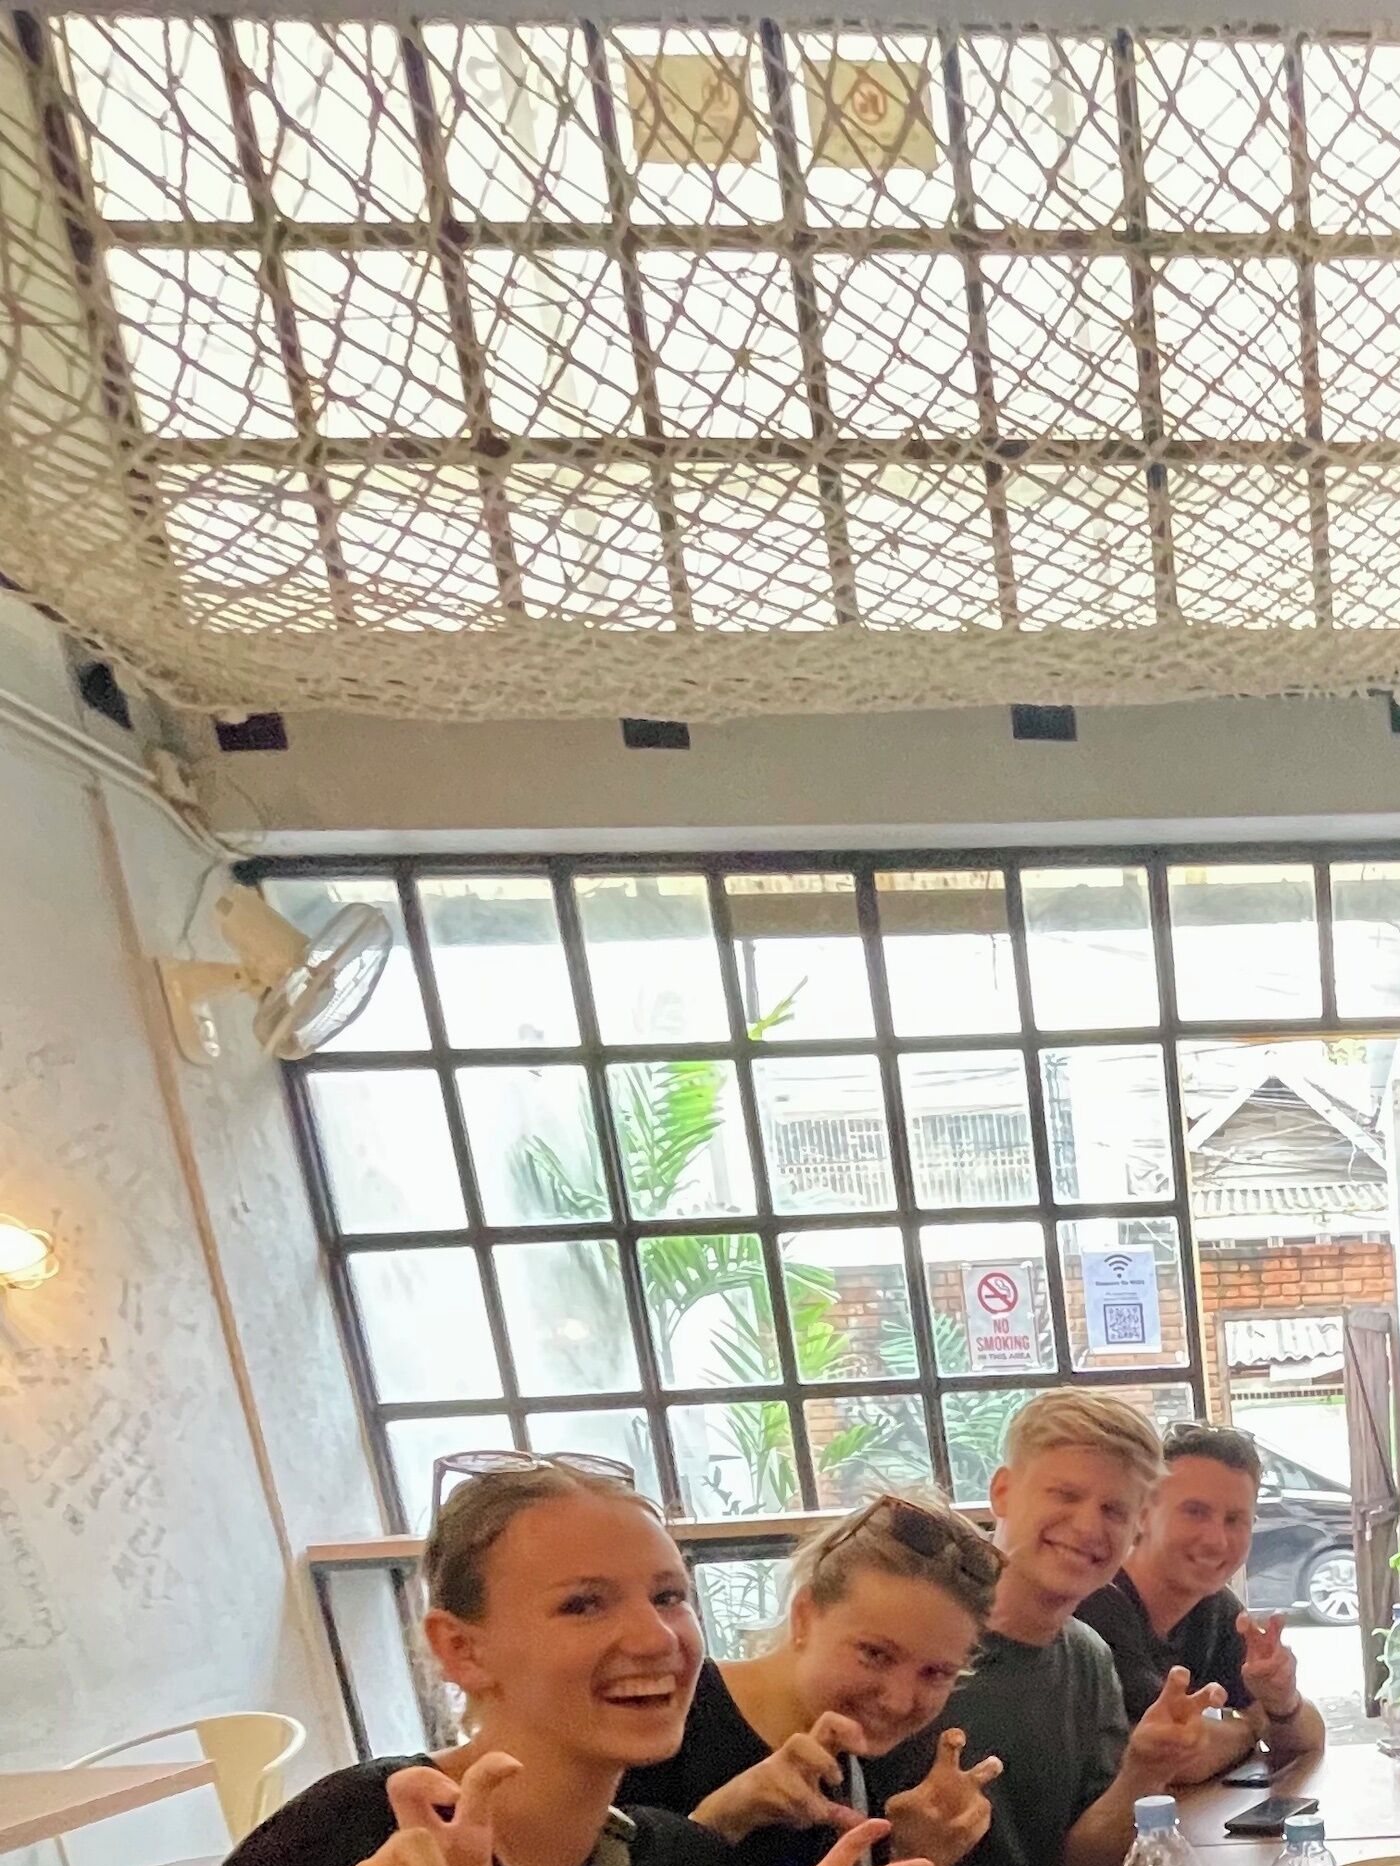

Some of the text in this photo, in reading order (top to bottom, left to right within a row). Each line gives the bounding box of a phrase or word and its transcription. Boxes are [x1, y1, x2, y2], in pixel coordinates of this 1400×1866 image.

[993, 1318, 1009, 1334] NO
[976, 1335, 1030, 1352] SMOKING
[1009, 1352, 1031, 1360] AREA
